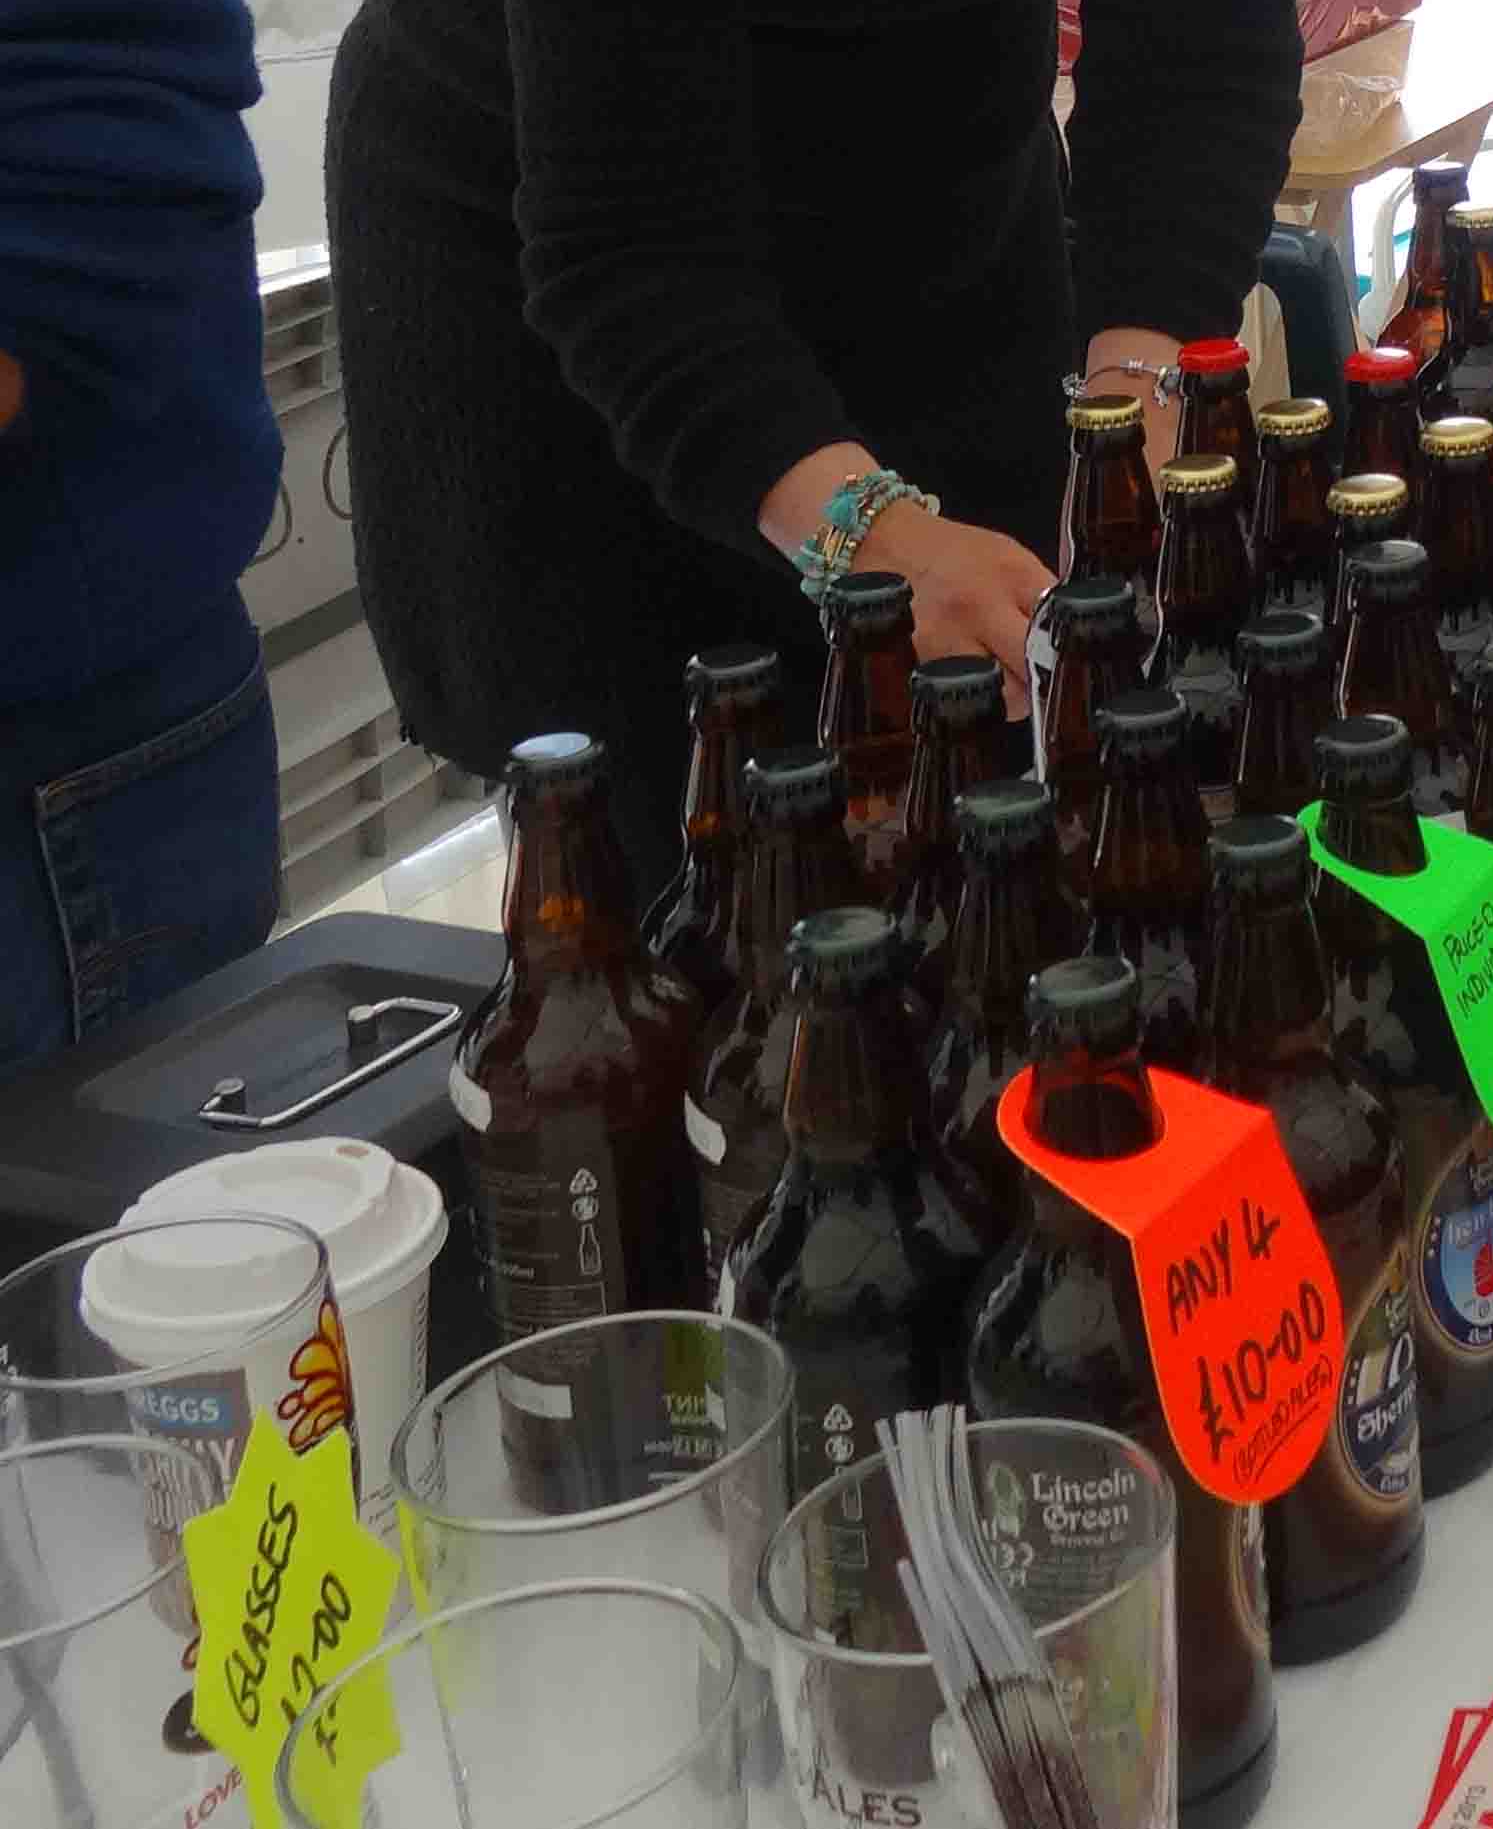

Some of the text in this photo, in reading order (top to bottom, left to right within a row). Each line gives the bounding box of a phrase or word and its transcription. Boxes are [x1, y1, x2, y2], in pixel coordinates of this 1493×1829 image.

[1166, 1197, 1281, 1337] ANY 4
[1032, 1467, 1137, 1504] Lincoln
[1042, 1503, 1128, 1532] Green
[223, 1480, 299, 1728] GLASSES
